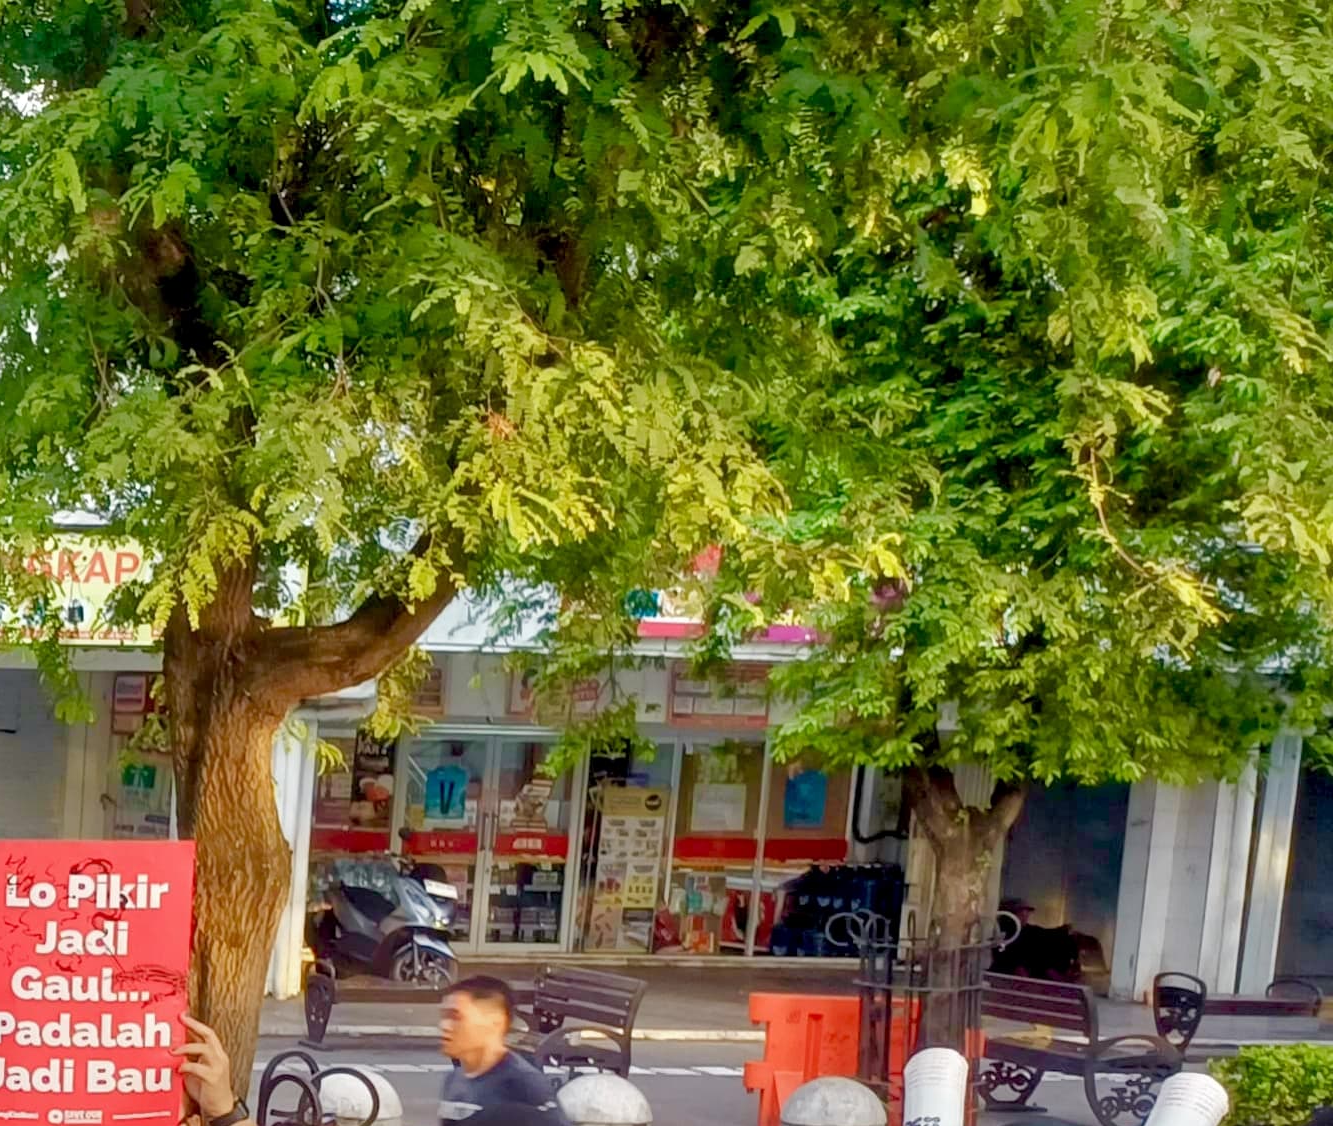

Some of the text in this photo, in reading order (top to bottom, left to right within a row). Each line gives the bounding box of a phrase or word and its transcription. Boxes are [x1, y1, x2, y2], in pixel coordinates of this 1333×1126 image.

[5, 873, 169, 909] Lo Pikir
[35, 920, 129, 956] Jadi
[86, 1059, 172, 1093] Bau
